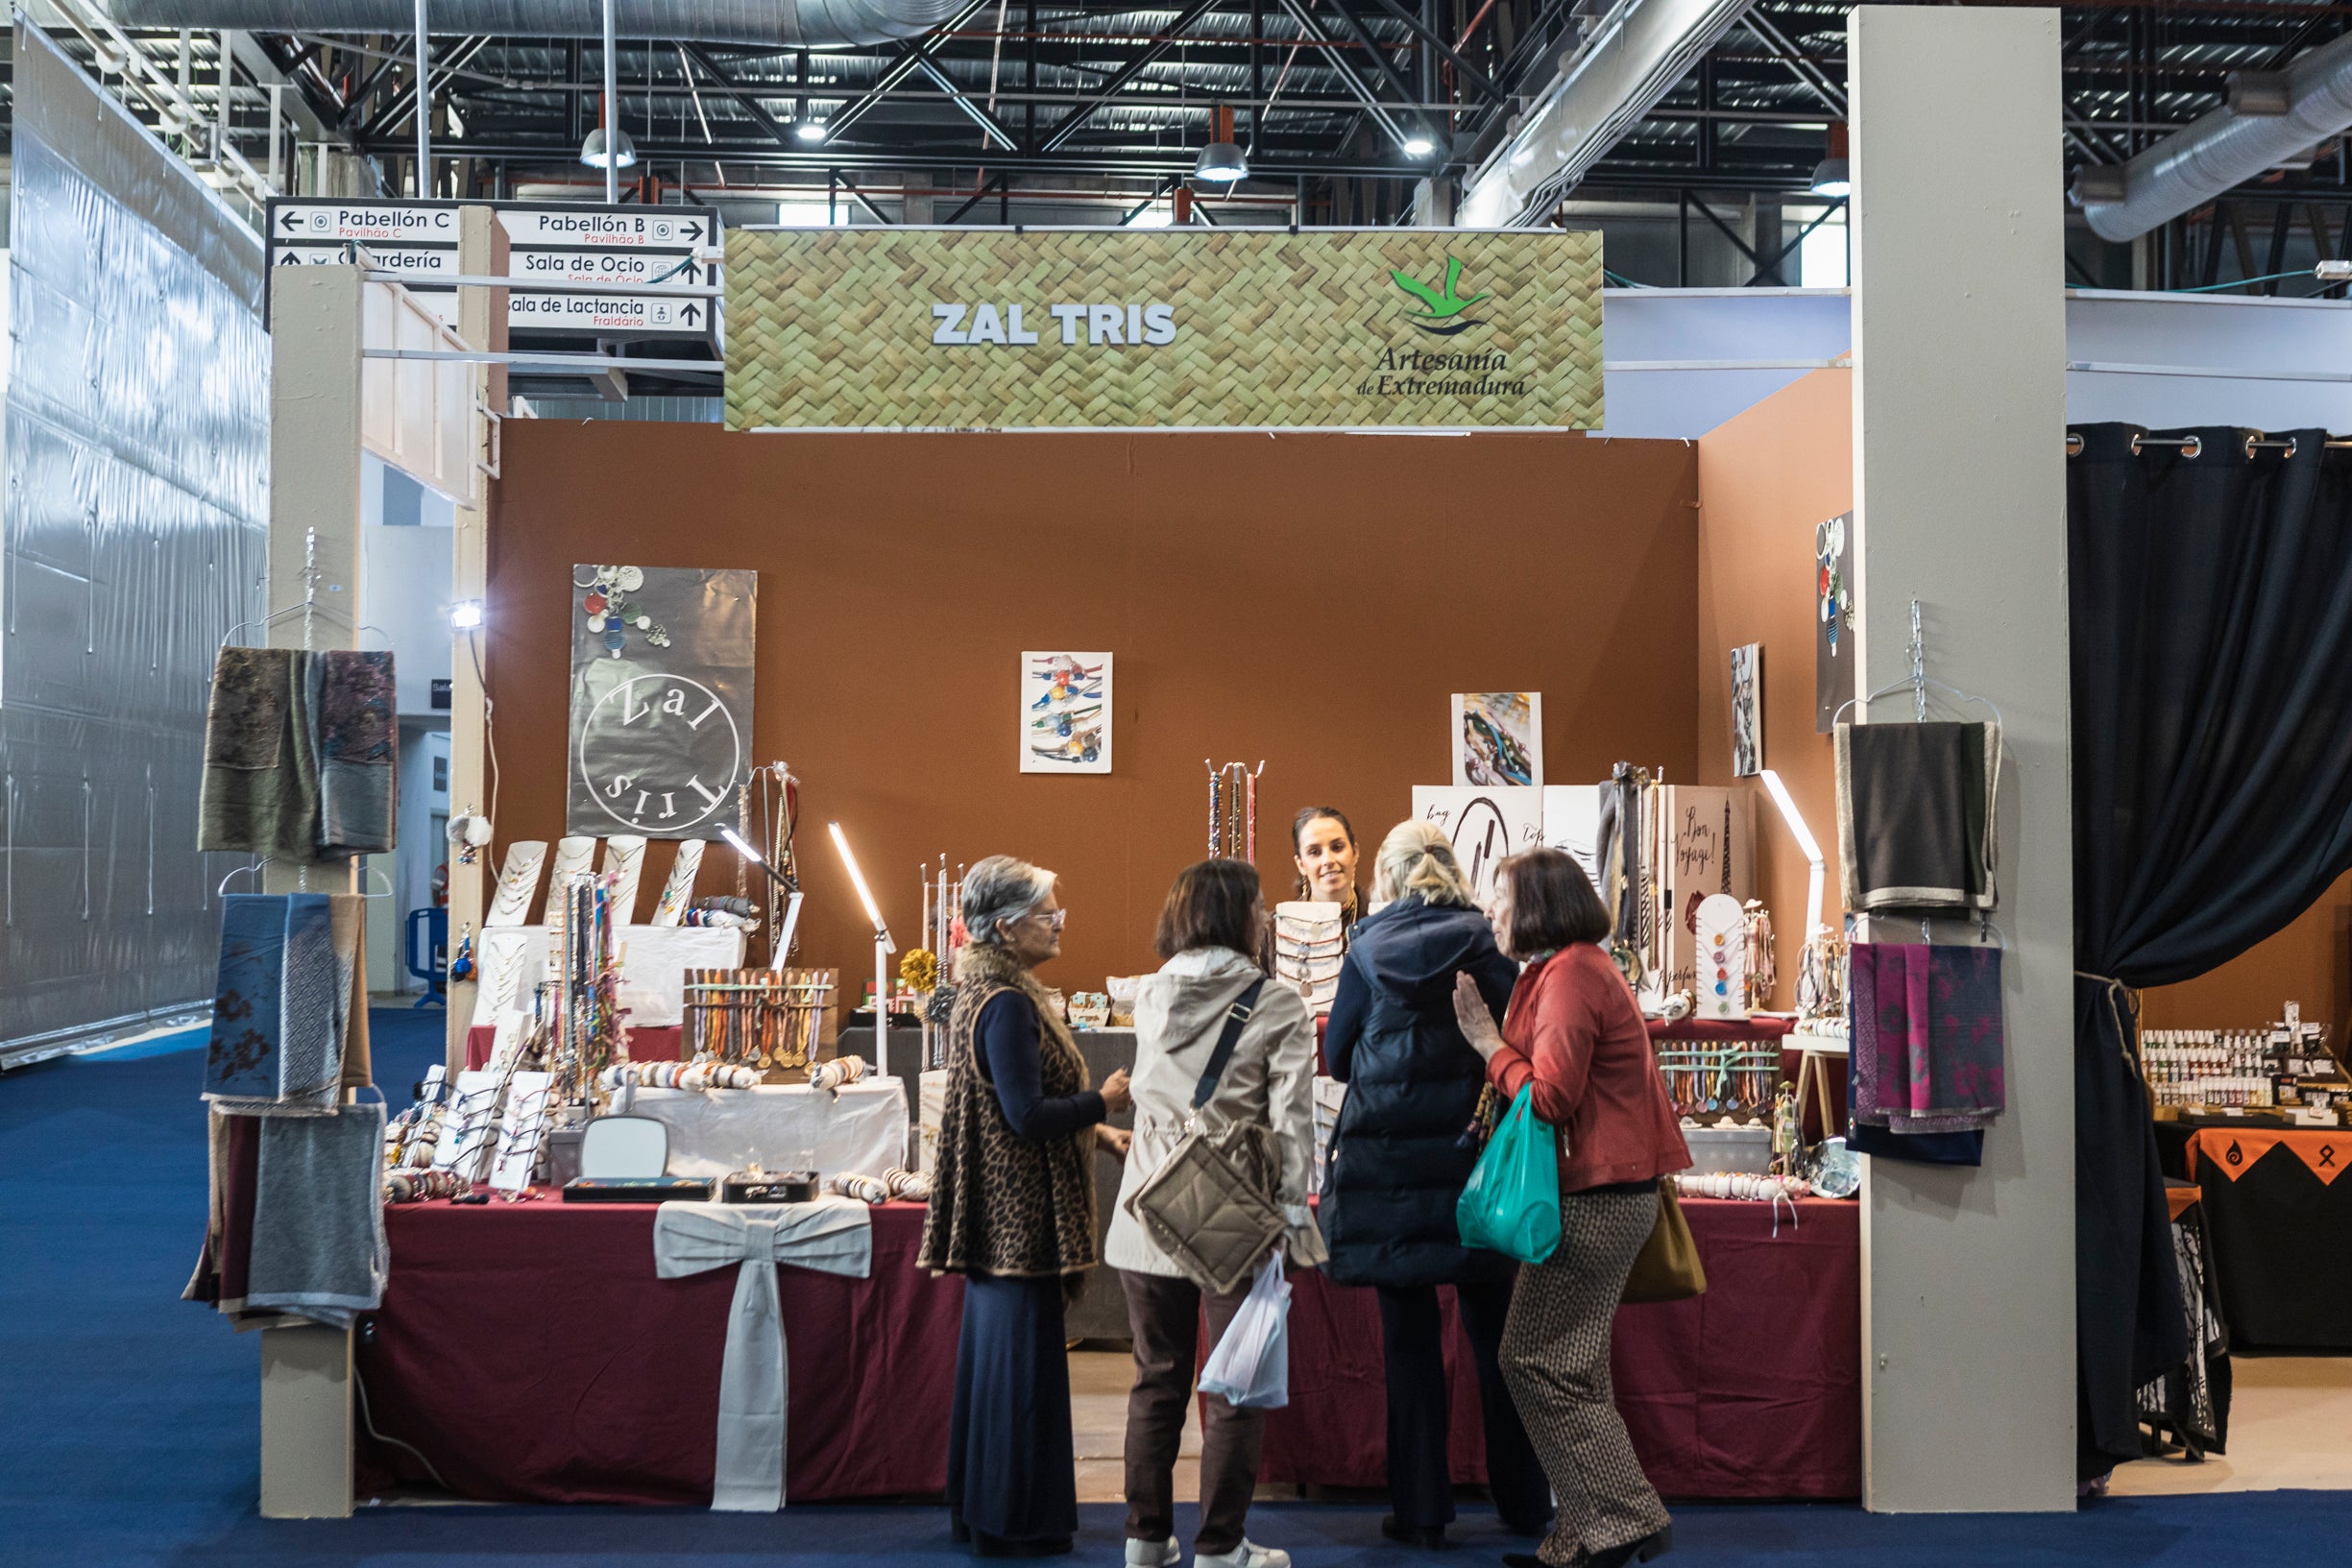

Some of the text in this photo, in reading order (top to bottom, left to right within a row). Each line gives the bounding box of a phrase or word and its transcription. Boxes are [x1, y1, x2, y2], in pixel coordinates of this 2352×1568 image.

[339, 209, 449, 228] Pabellón C
[539, 214, 645, 232] Pabellón B
[339, 228, 401, 238] Pavilhão C
[584, 233, 644, 245] Pavilhão B
[339, 251, 441, 269] rdería
[526, 254, 644, 272] Sala de Ocio
[508, 297, 643, 315] ala de Lactancia
[594, 315, 644, 326] Fraldário
[932, 303, 1177, 346] ZAL TRIS
[1375, 347, 1508, 372] Artesanía
[1356, 374, 1525, 396] de Extremadura
[608, 681, 721, 731] Zal
[604, 774, 727, 826] Tris
[1685, 806, 1710, 843] Bon
